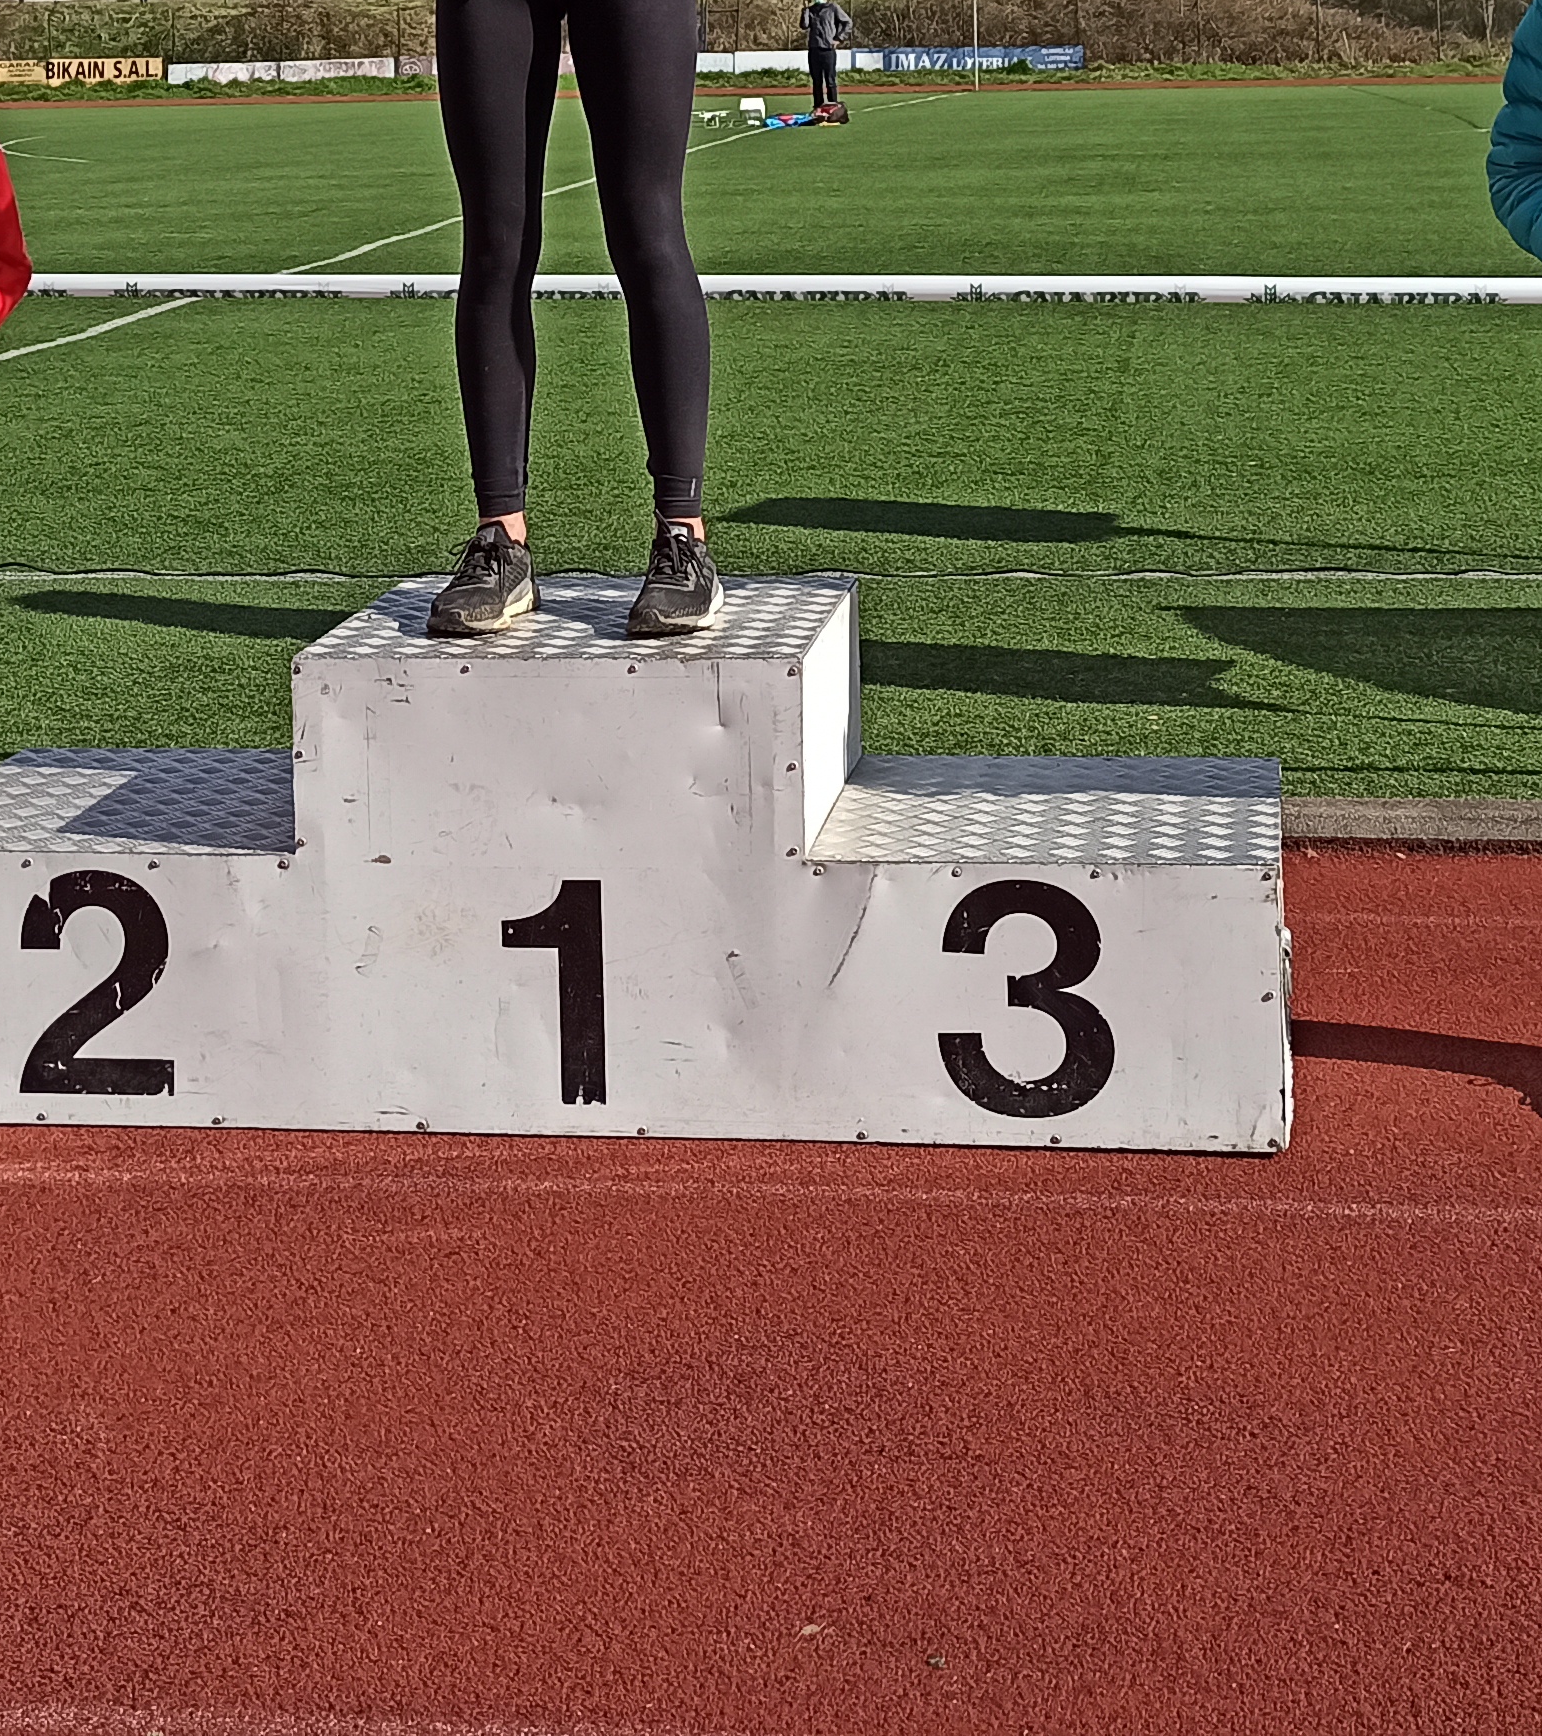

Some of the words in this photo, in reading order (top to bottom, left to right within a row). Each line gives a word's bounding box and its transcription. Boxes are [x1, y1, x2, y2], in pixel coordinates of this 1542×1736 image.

[46, 61, 105, 80] BIKAIN
[113, 60, 159, 79] S.A.L.
[890, 53, 948, 71] IMAZ
[19, 869, 176, 1096] 2
[500, 878, 608, 1106] 1
[937, 879, 1116, 1118] 3
